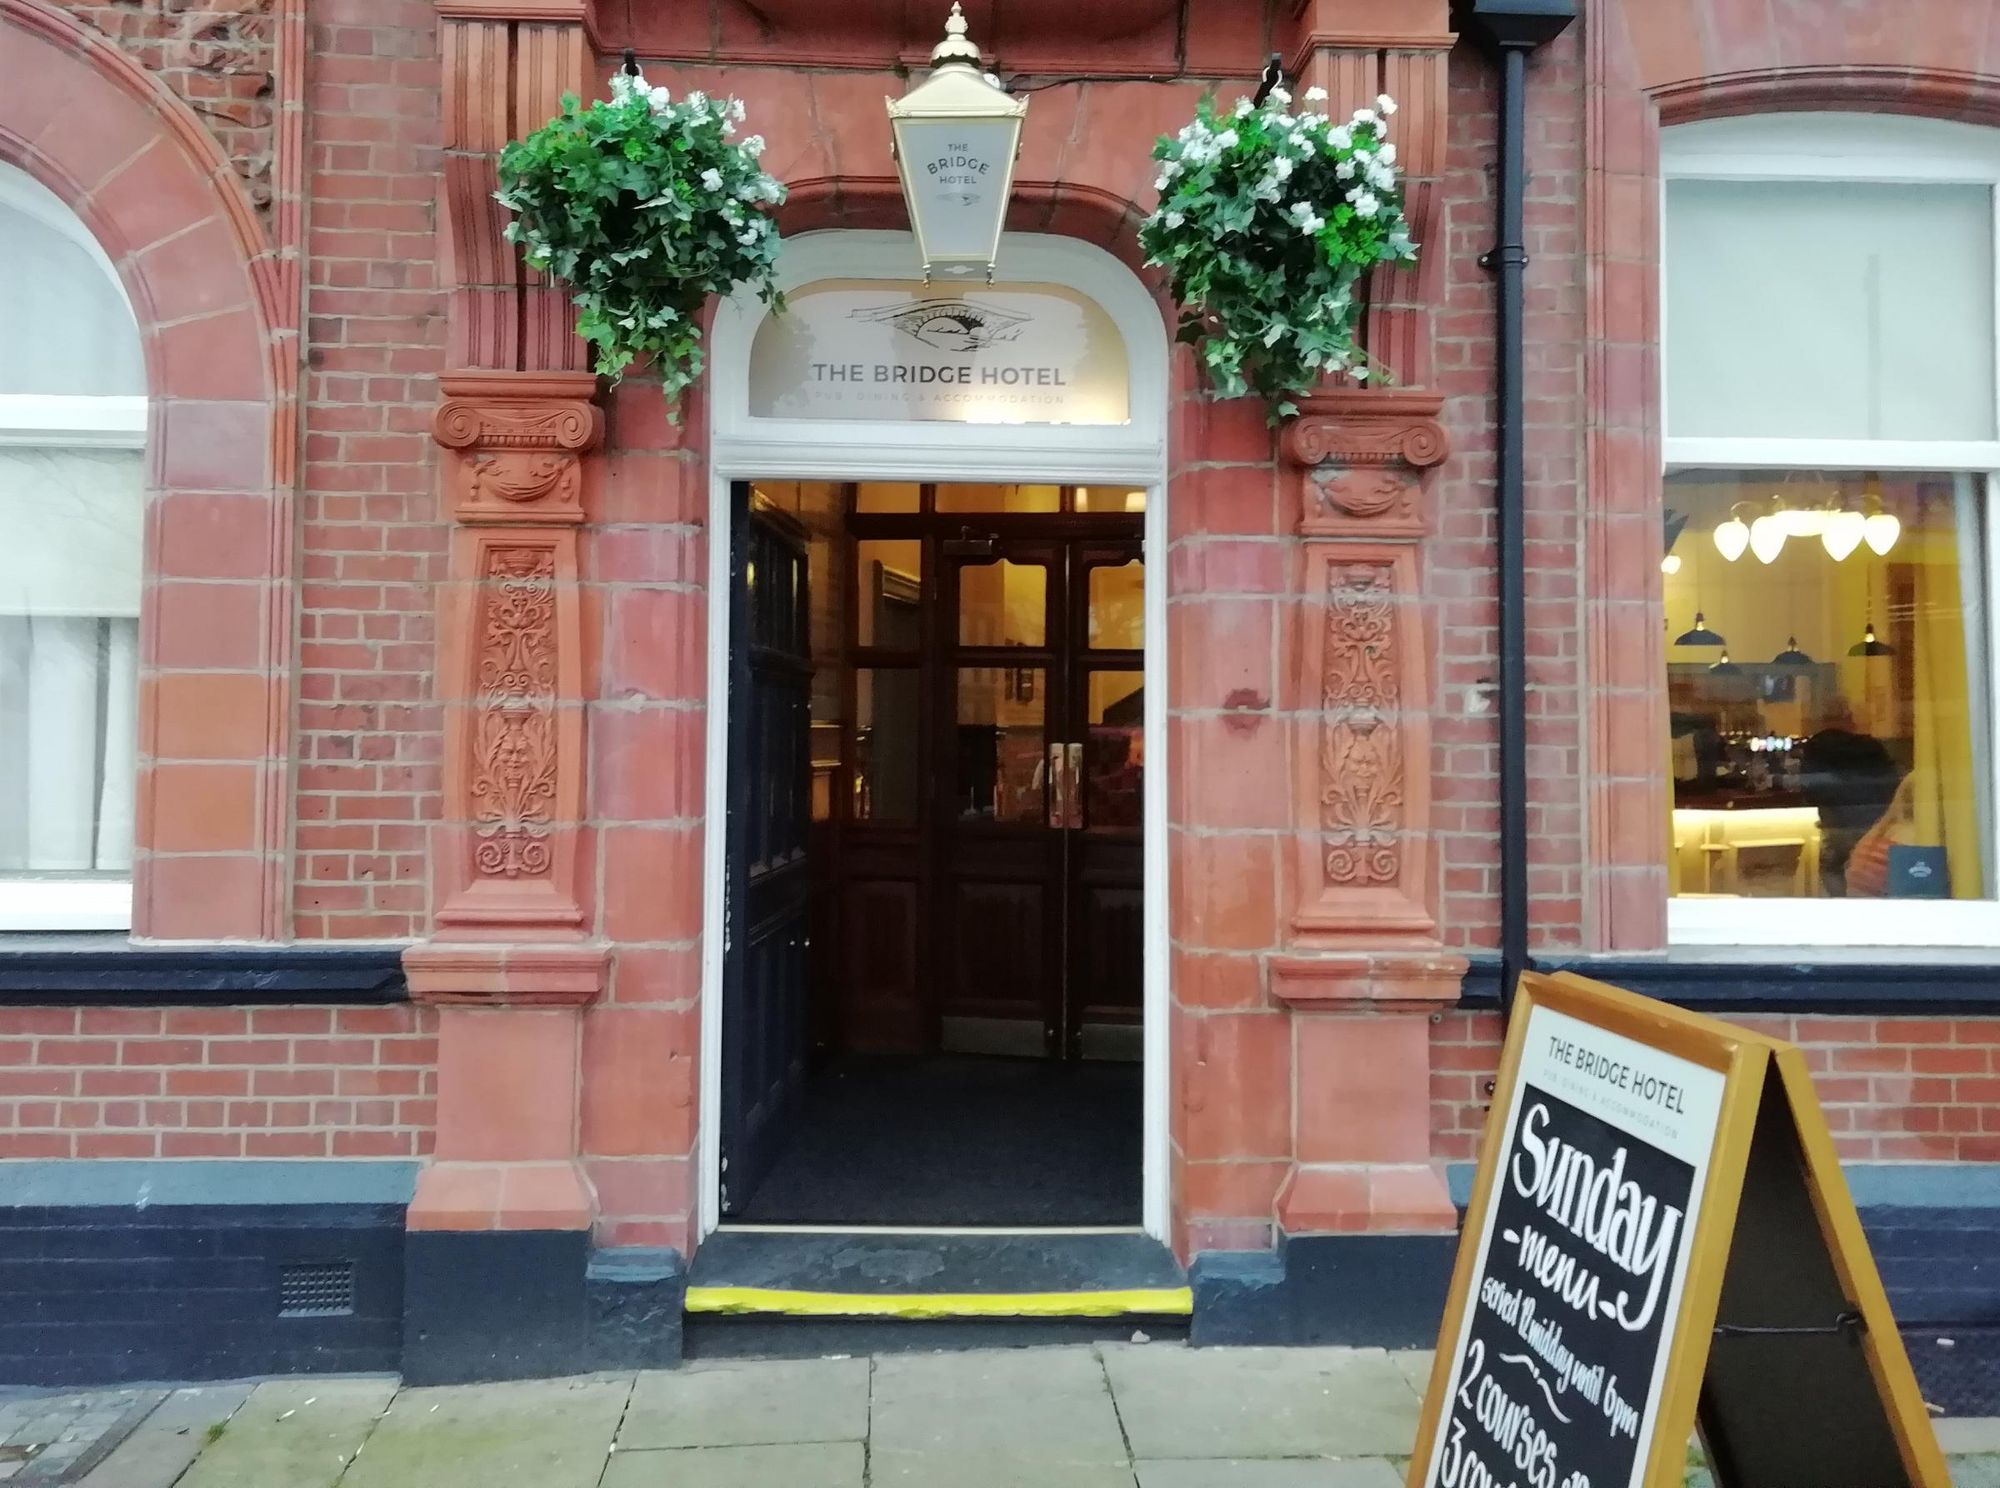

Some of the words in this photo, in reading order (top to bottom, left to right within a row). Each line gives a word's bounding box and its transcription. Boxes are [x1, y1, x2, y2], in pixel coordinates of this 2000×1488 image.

[926, 156, 990, 175] BRIDGE
[939, 175, 978, 185] HOTEL
[947, 143, 969, 152] THE
[812, 363, 864, 382] THE
[874, 365, 972, 385] BRIDGE
[981, 366, 1066, 386] HOTEL
[1548, 1036, 1575, 1065] THE
[1575, 1047, 1631, 1090] BRIDGE
[1632, 1070, 1684, 1115] HOTEL
[1512, 1102, 1684, 1332] Sunday
[1526, 1318, 1575, 1394] midday
[1456, 1338, 1486, 1411] 2
[1476, 1373, 1558, 1488] courses
[1441, 1416, 1467, 1488] 3
